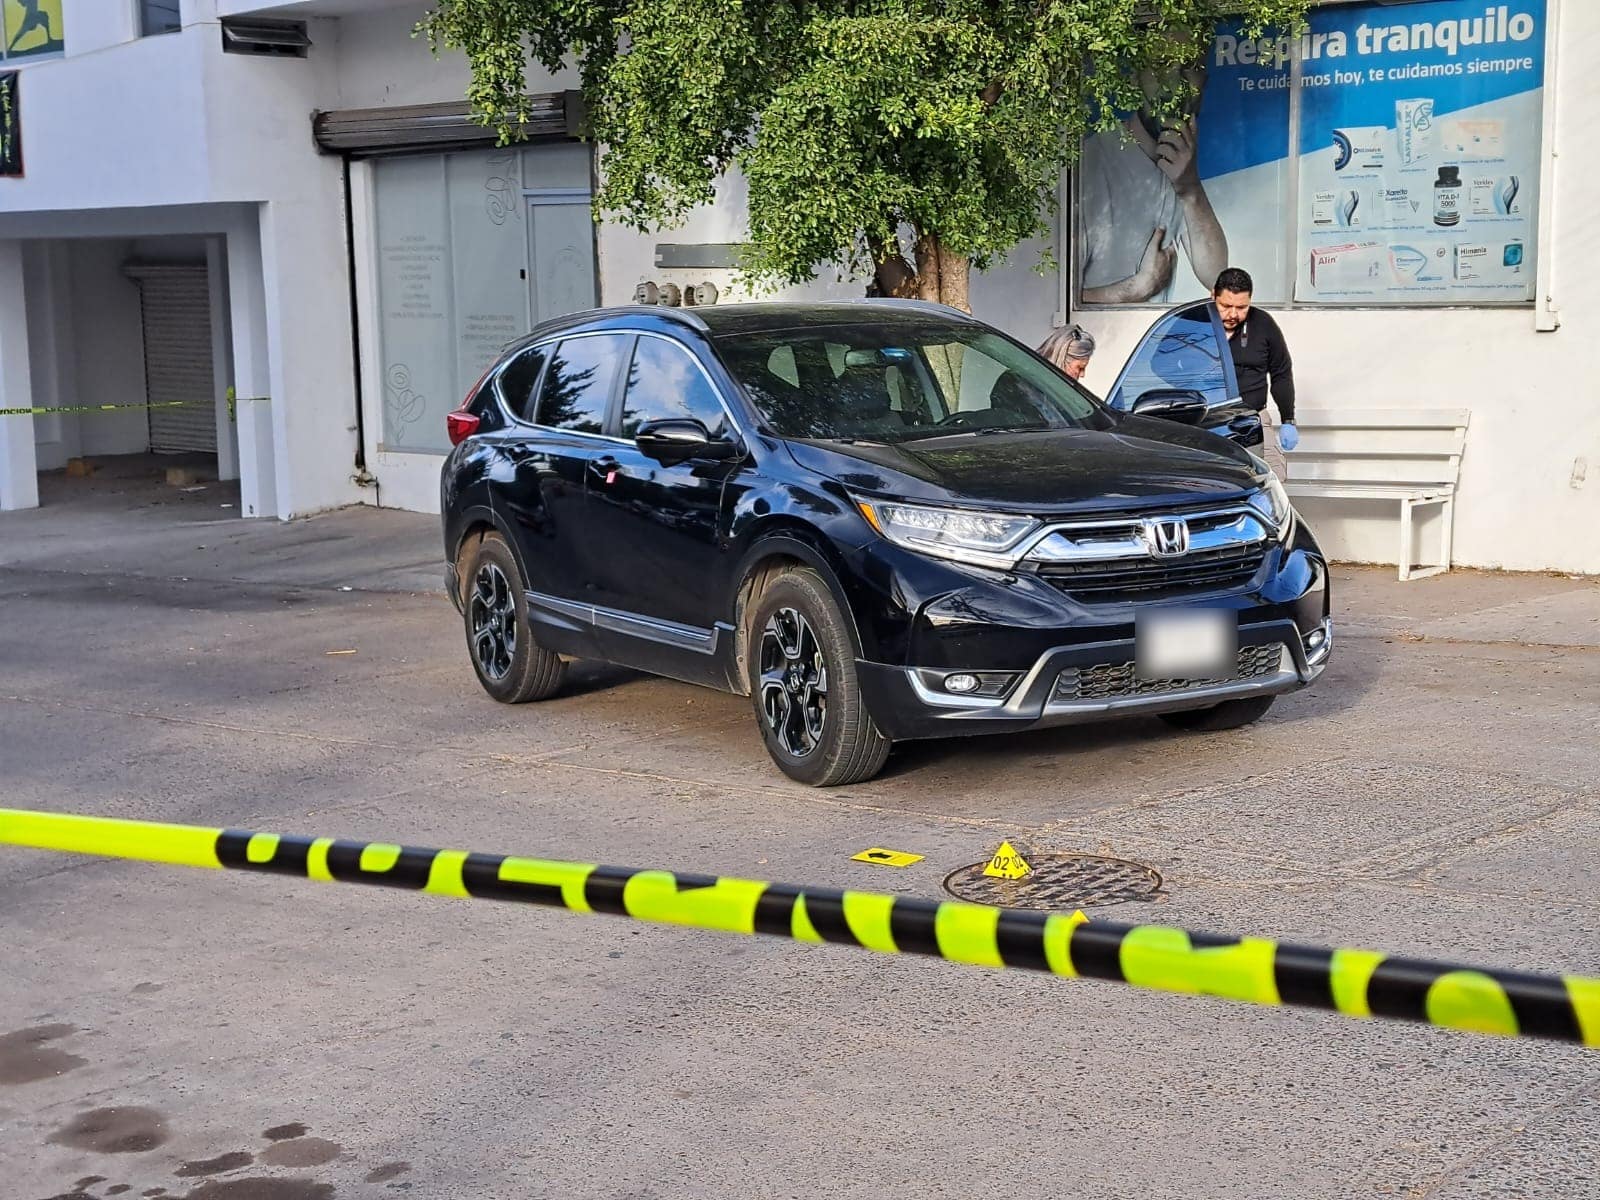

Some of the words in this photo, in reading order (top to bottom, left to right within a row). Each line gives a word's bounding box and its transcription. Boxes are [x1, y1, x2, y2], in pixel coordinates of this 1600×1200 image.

[1215, 27, 1347, 70] Respira
[1356, 6, 1534, 55] tranquilo
[1239, 77, 1254, 91] Te
[1258, 73, 1331, 90] cuidamos
[1335, 69, 1365, 86] hoy,
[1369, 68, 1385, 81] te
[1388, 62, 1463, 79] cuidamos
[1467, 57, 1533, 74] siempre
[1318, 256, 1336, 265] Alin
[994, 856, 1010, 870] 02
